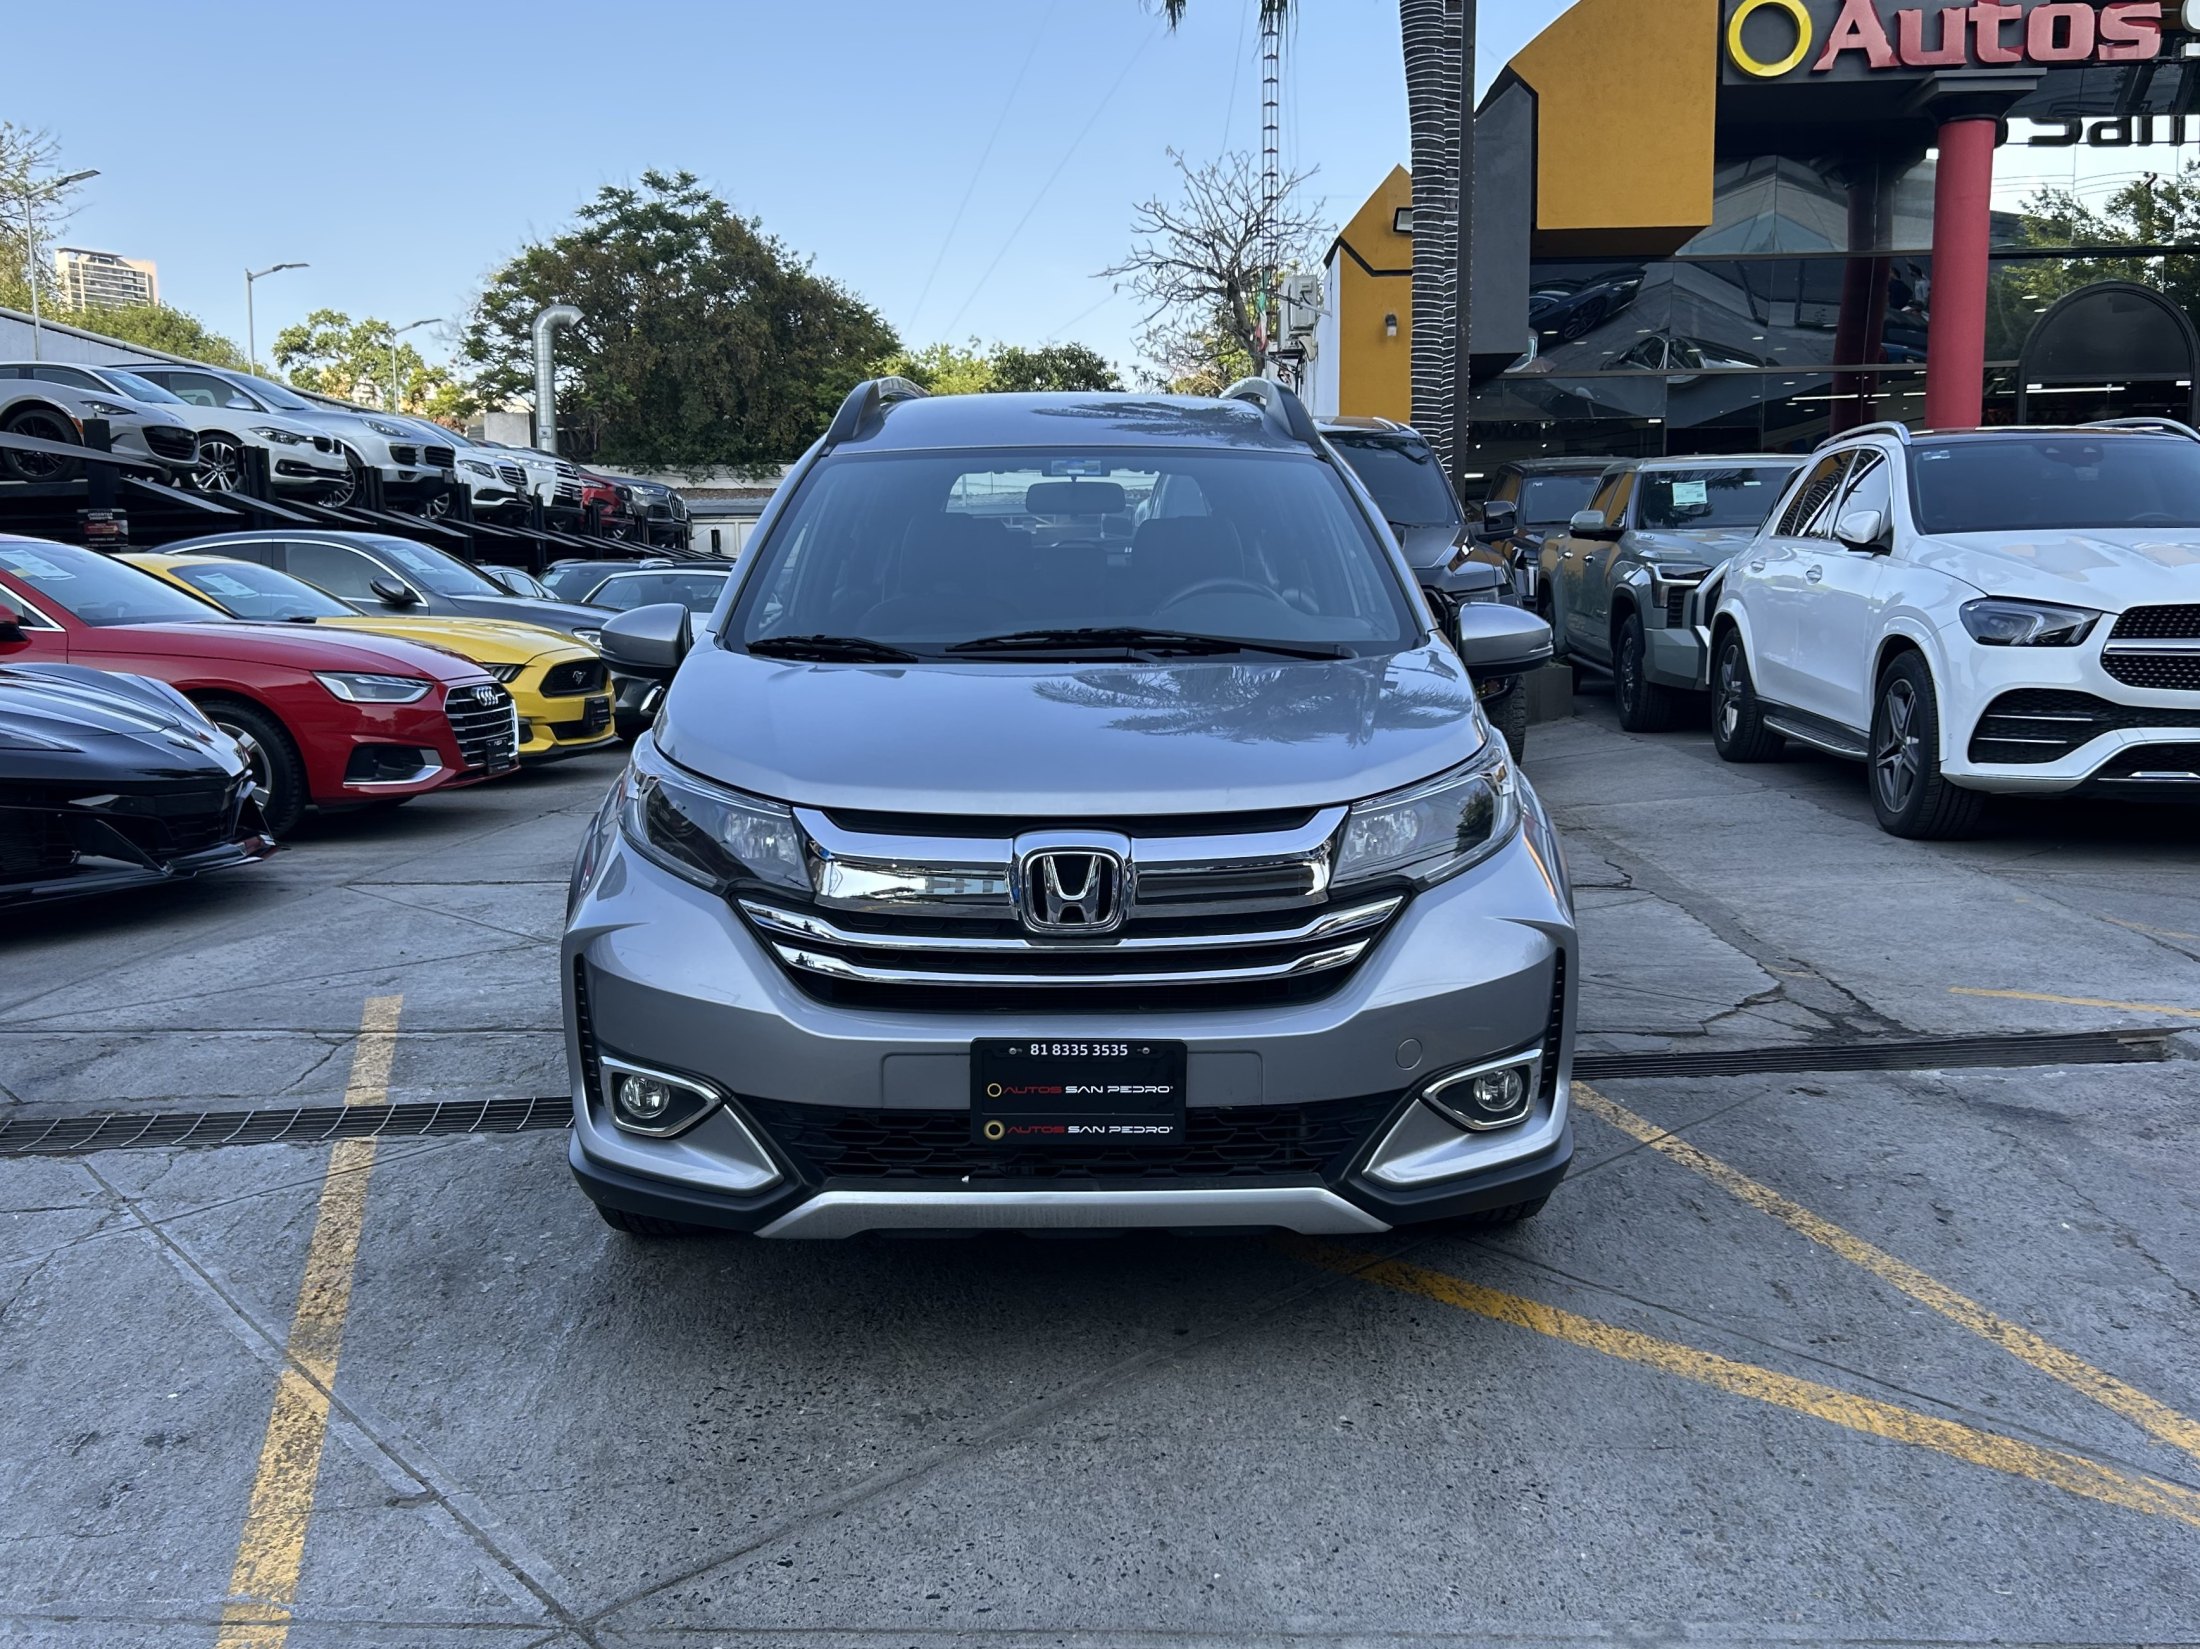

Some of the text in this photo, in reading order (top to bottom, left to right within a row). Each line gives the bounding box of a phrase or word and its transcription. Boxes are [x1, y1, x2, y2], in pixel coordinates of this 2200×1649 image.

[1811, 0, 2163, 71] Autos
[1030, 1043, 1128, 1056] 81 8335 3535
[1003, 1086, 1062, 1094] AUTOS
[1065, 1085, 1104, 1094] SAN
[1007, 1125, 1064, 1134] AUTOS
[1067, 1125, 1105, 1134] SAN
